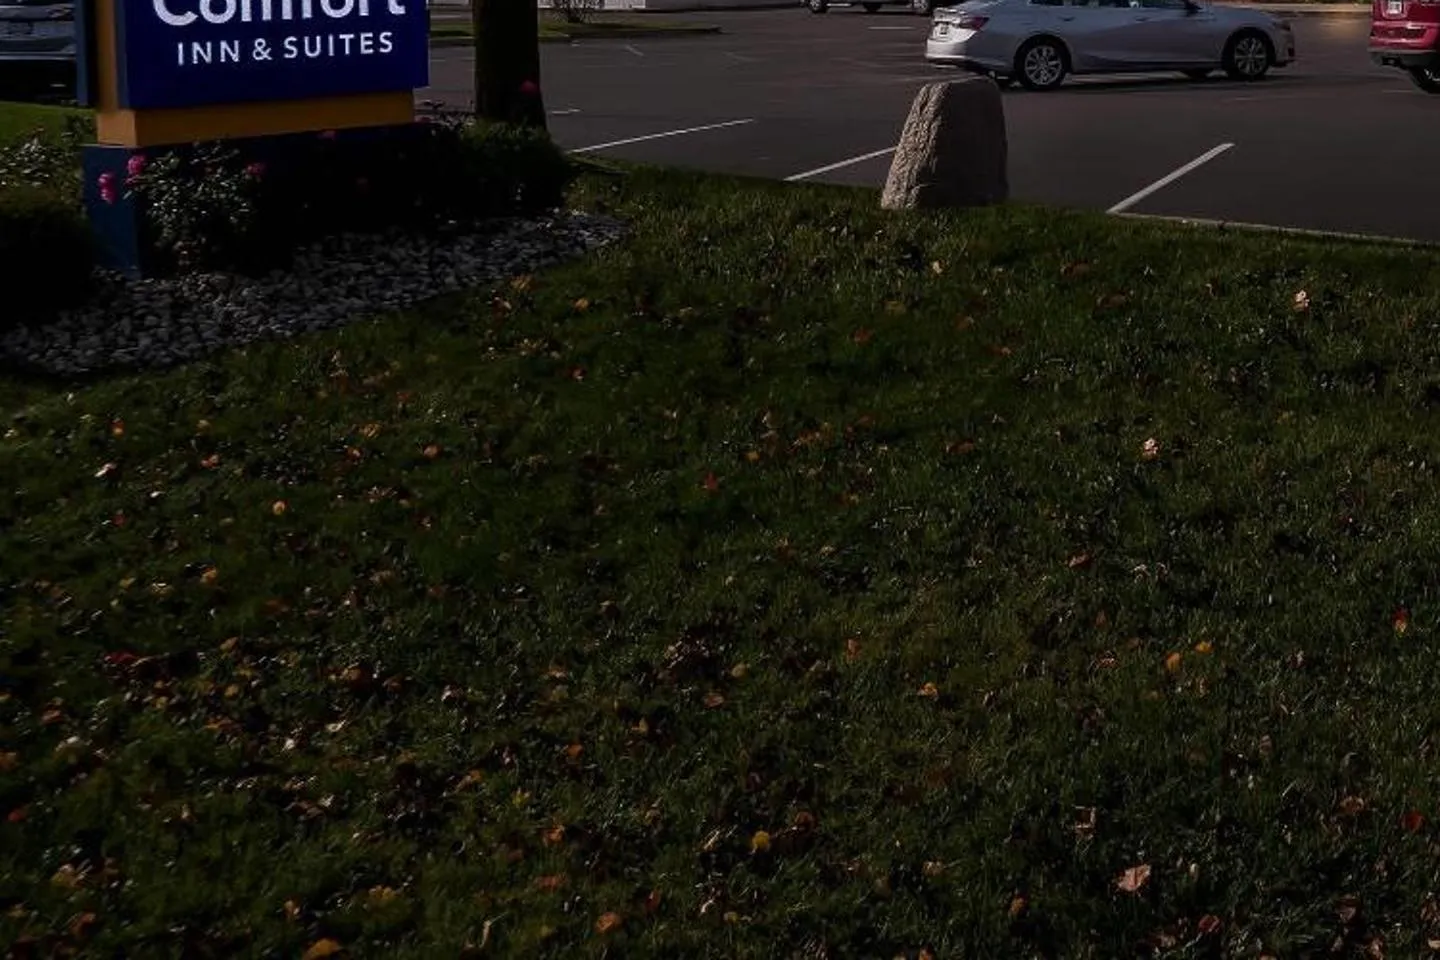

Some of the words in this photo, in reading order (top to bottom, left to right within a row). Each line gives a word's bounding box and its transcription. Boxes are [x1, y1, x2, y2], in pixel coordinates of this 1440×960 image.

[177, 39, 241, 67] INN
[251, 38, 274, 62] &
[284, 31, 395, 59] SUITES
